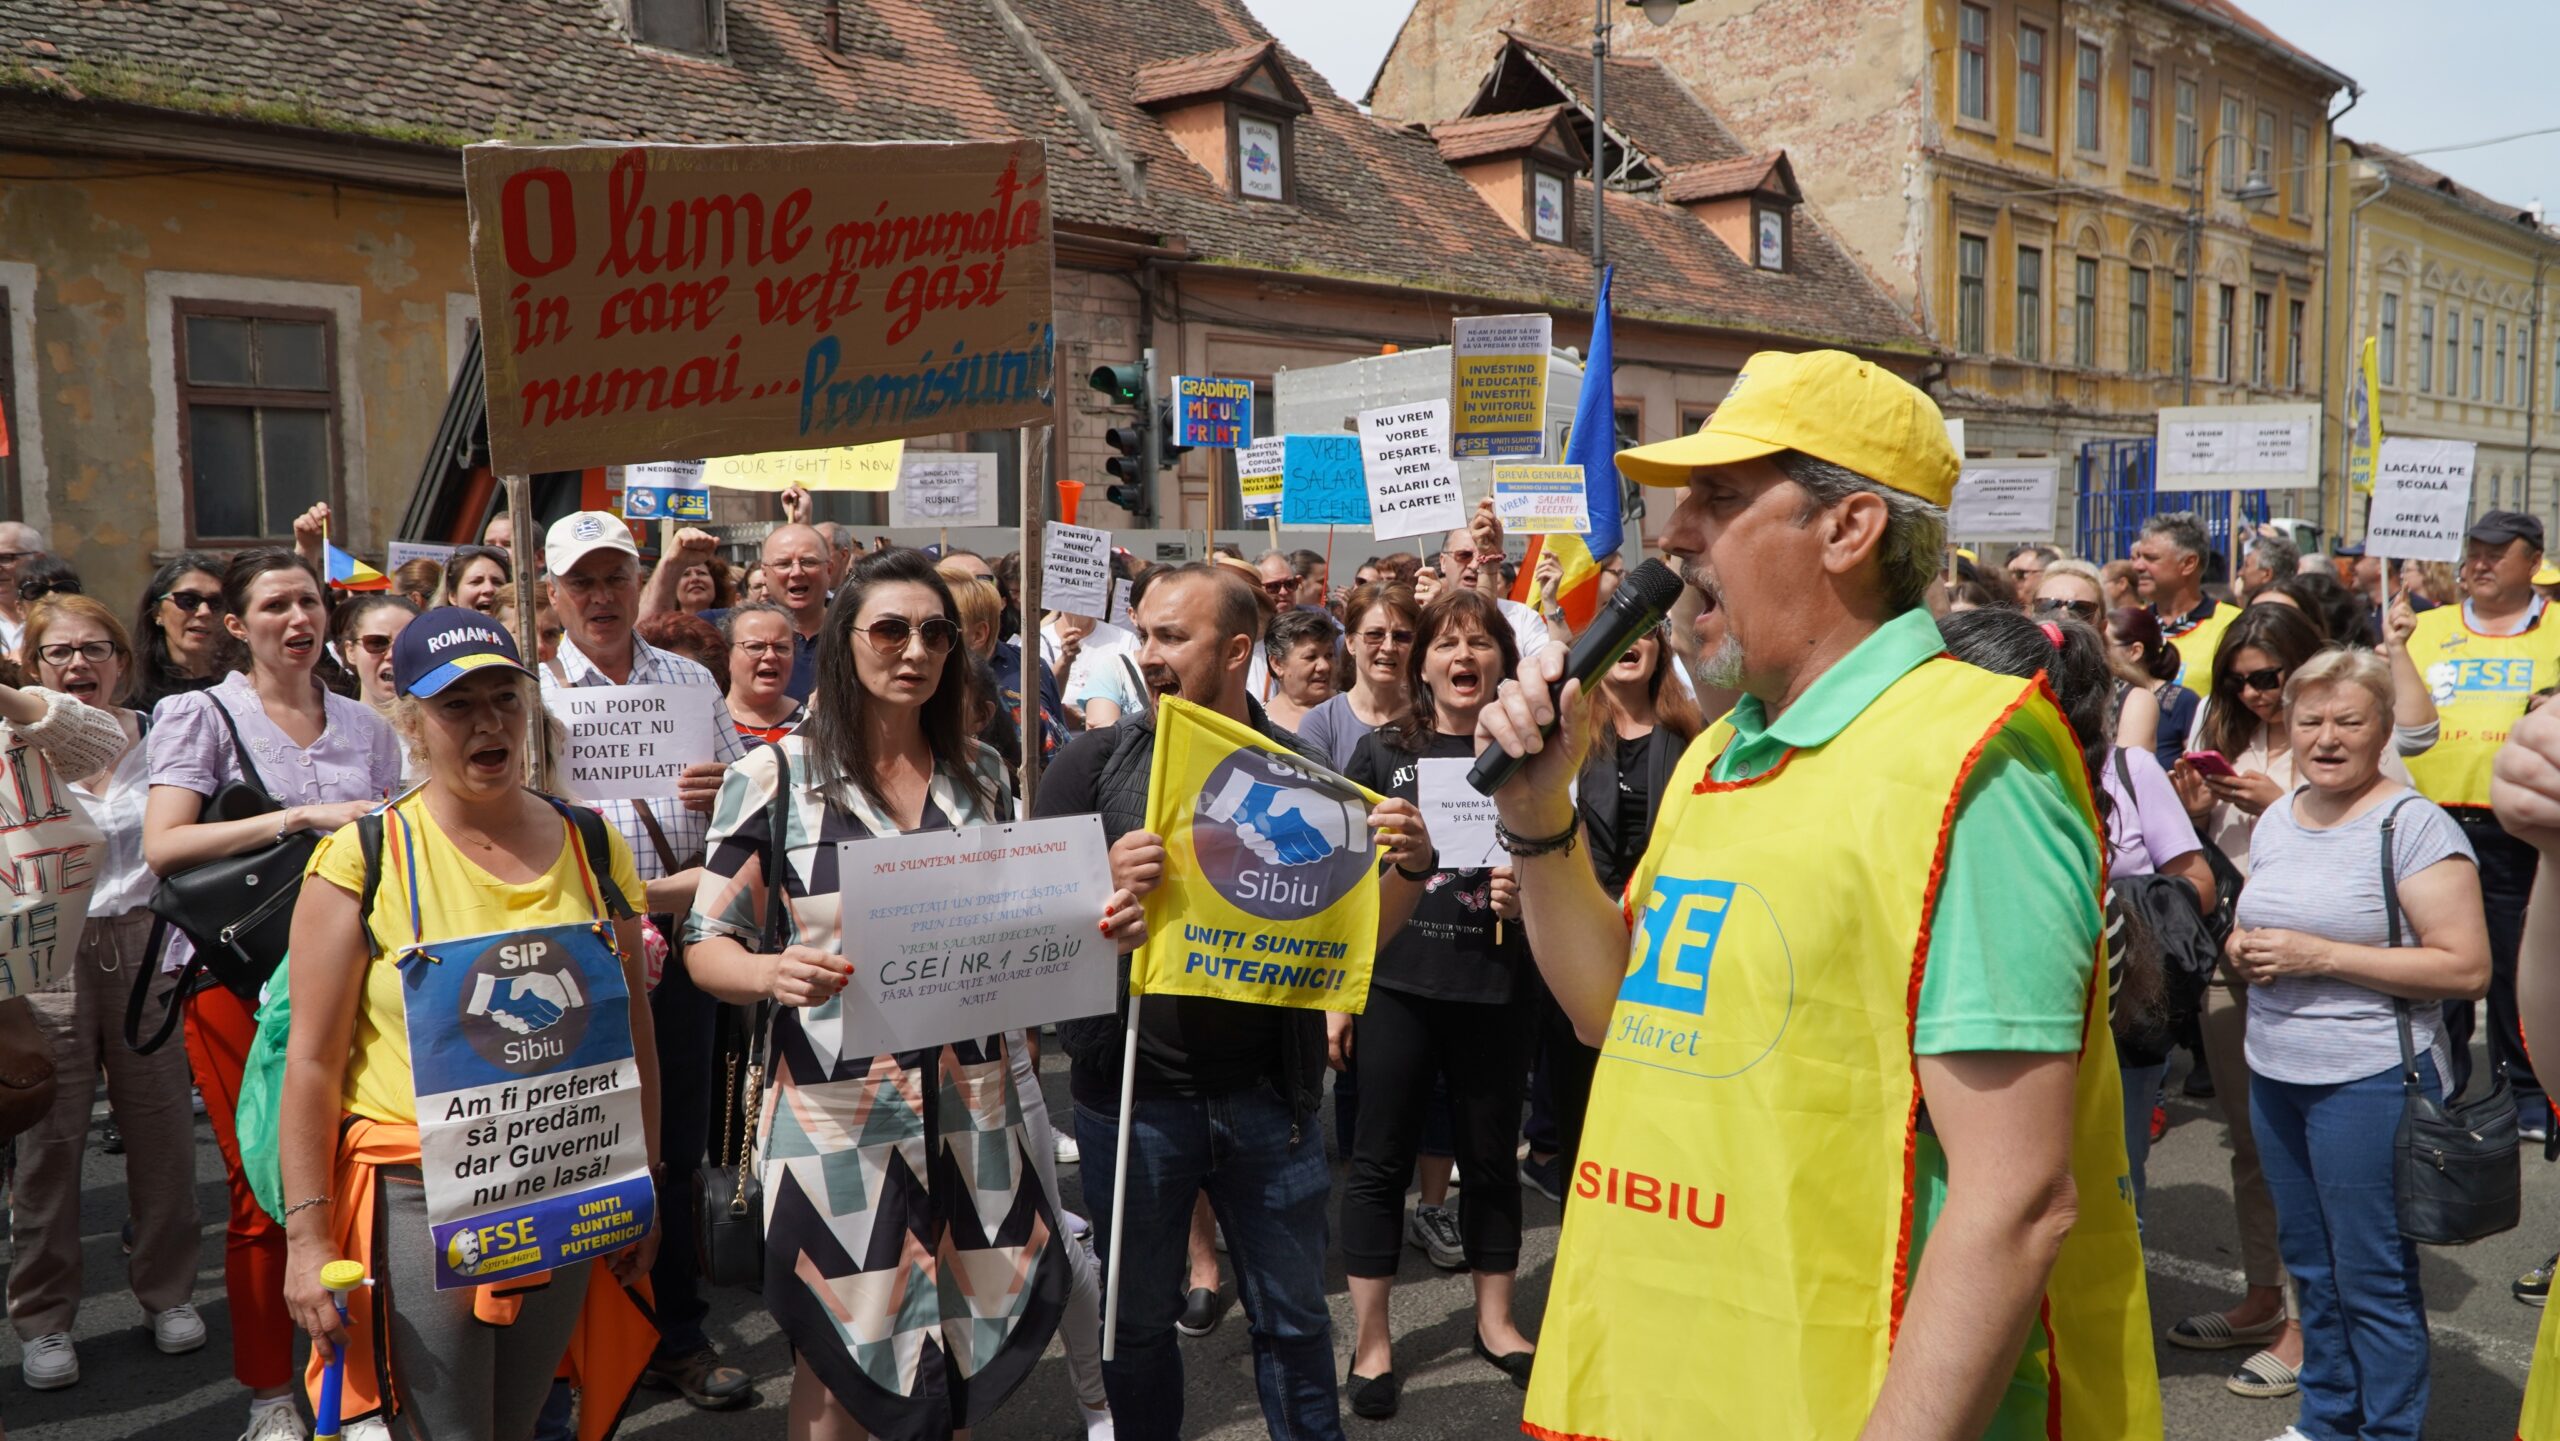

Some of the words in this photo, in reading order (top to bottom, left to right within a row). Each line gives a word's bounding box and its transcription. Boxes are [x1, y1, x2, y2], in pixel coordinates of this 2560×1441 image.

[502, 166, 577, 279] O
[596, 147, 814, 278] lume
[595, 274, 730, 340] care
[1469, 364, 1535, 375] INVESTIND
[1461, 376, 1473, 387] ÎN
[1477, 376, 1542, 389] EDUCAȚIE,
[1463, 401, 1476, 412] ÎN
[1480, 401, 1537, 412] VIITORUL
[1376, 416, 1394, 427] NU
[1398, 410, 1434, 424] VREM
[1386, 428, 1429, 442] VORBE
[1468, 438, 1489, 449] FSE
[1307, 438, 1362, 461] VREM
[724, 459, 768, 475] OUR
[1394, 462, 1430, 476] VREM
[2384, 463, 2444, 474] LACĂTUL
[2449, 467, 2465, 475] PE
[1380, 480, 1429, 495] SALARII
[1433, 476, 1450, 486] CA
[680, 495, 705, 508] FSE
[1380, 503, 1396, 513] LA
[1399, 494, 1441, 510] CARTE
[1445, 493, 1456, 503] !!!
[1500, 495, 1529, 513] VREM
[1537, 496, 1573, 504] SALARII
[1056, 530, 1093, 542] PENTRU
[1052, 553, 1090, 565] TREBUIE
[1048, 564, 1073, 573] AVEM
[1075, 568, 1091, 577] DIN
[1093, 571, 1105, 579] CE
[2456, 661, 2530, 687] FSE
[571, 700, 596, 715] UN
[606, 698, 666, 714] POPOR
[572, 721, 642, 738] EDUCAT
[651, 720, 675, 734] NU
[572, 743, 630, 759] POATE
[639, 743, 654, 756] FI
[1441, 801, 1454, 809] NU
[1456, 800, 1480, 808] VREM
[1475, 813, 1485, 821] NE
[873, 862, 896, 874] NU
[899, 855, 955, 872] SUNTEM
[959, 849, 1006, 864] MILOGII
[1236, 869, 1319, 907] Sibiu
[952, 896, 973, 910] UN
[975, 889, 1018, 906] DREPT
[911, 919, 945, 933] PRIN
[949, 914, 979, 928] LEGE
[1455, 924, 1484, 934] WINGS
[898, 940, 939, 956] VREM
[942, 933, 996, 950] SALARII
[999, 924, 1057, 942] DECENTE
[1184, 923, 1246, 953] UNIȚI
[1252, 934, 1348, 959] SUNTEM
[499, 941, 547, 970] SIP
[960, 952, 991, 975] NR
[1000, 950, 1011, 970] 1
[986, 968, 1032, 985] MOARE
[1035, 961, 1071, 976] ORICE
[1185, 951, 1346, 990] PUTERNICI!
[1617, 1014, 1702, 1057] Haret
[503, 1036, 564, 1064] Sibiu
[445, 1096, 491, 1121] Am
[501, 1086, 518, 1111] fi
[526, 1067, 619, 1112] preferat
[466, 1120, 497, 1147] să
[507, 1103, 606, 1145] predăm,
[455, 1154, 501, 1180] dar
[509, 1123, 620, 1169] Guvernul
[473, 1184, 506, 1207] nu
[515, 1174, 545, 1197] ne
[553, 1154, 611, 1188] lasă!
[1575, 1161, 1726, 1229] SIBIU
[578, 1196, 622, 1217] UNIȚI
[570, 1210, 633, 1237] SUNTEM
[478, 1216, 537, 1255] FSE
